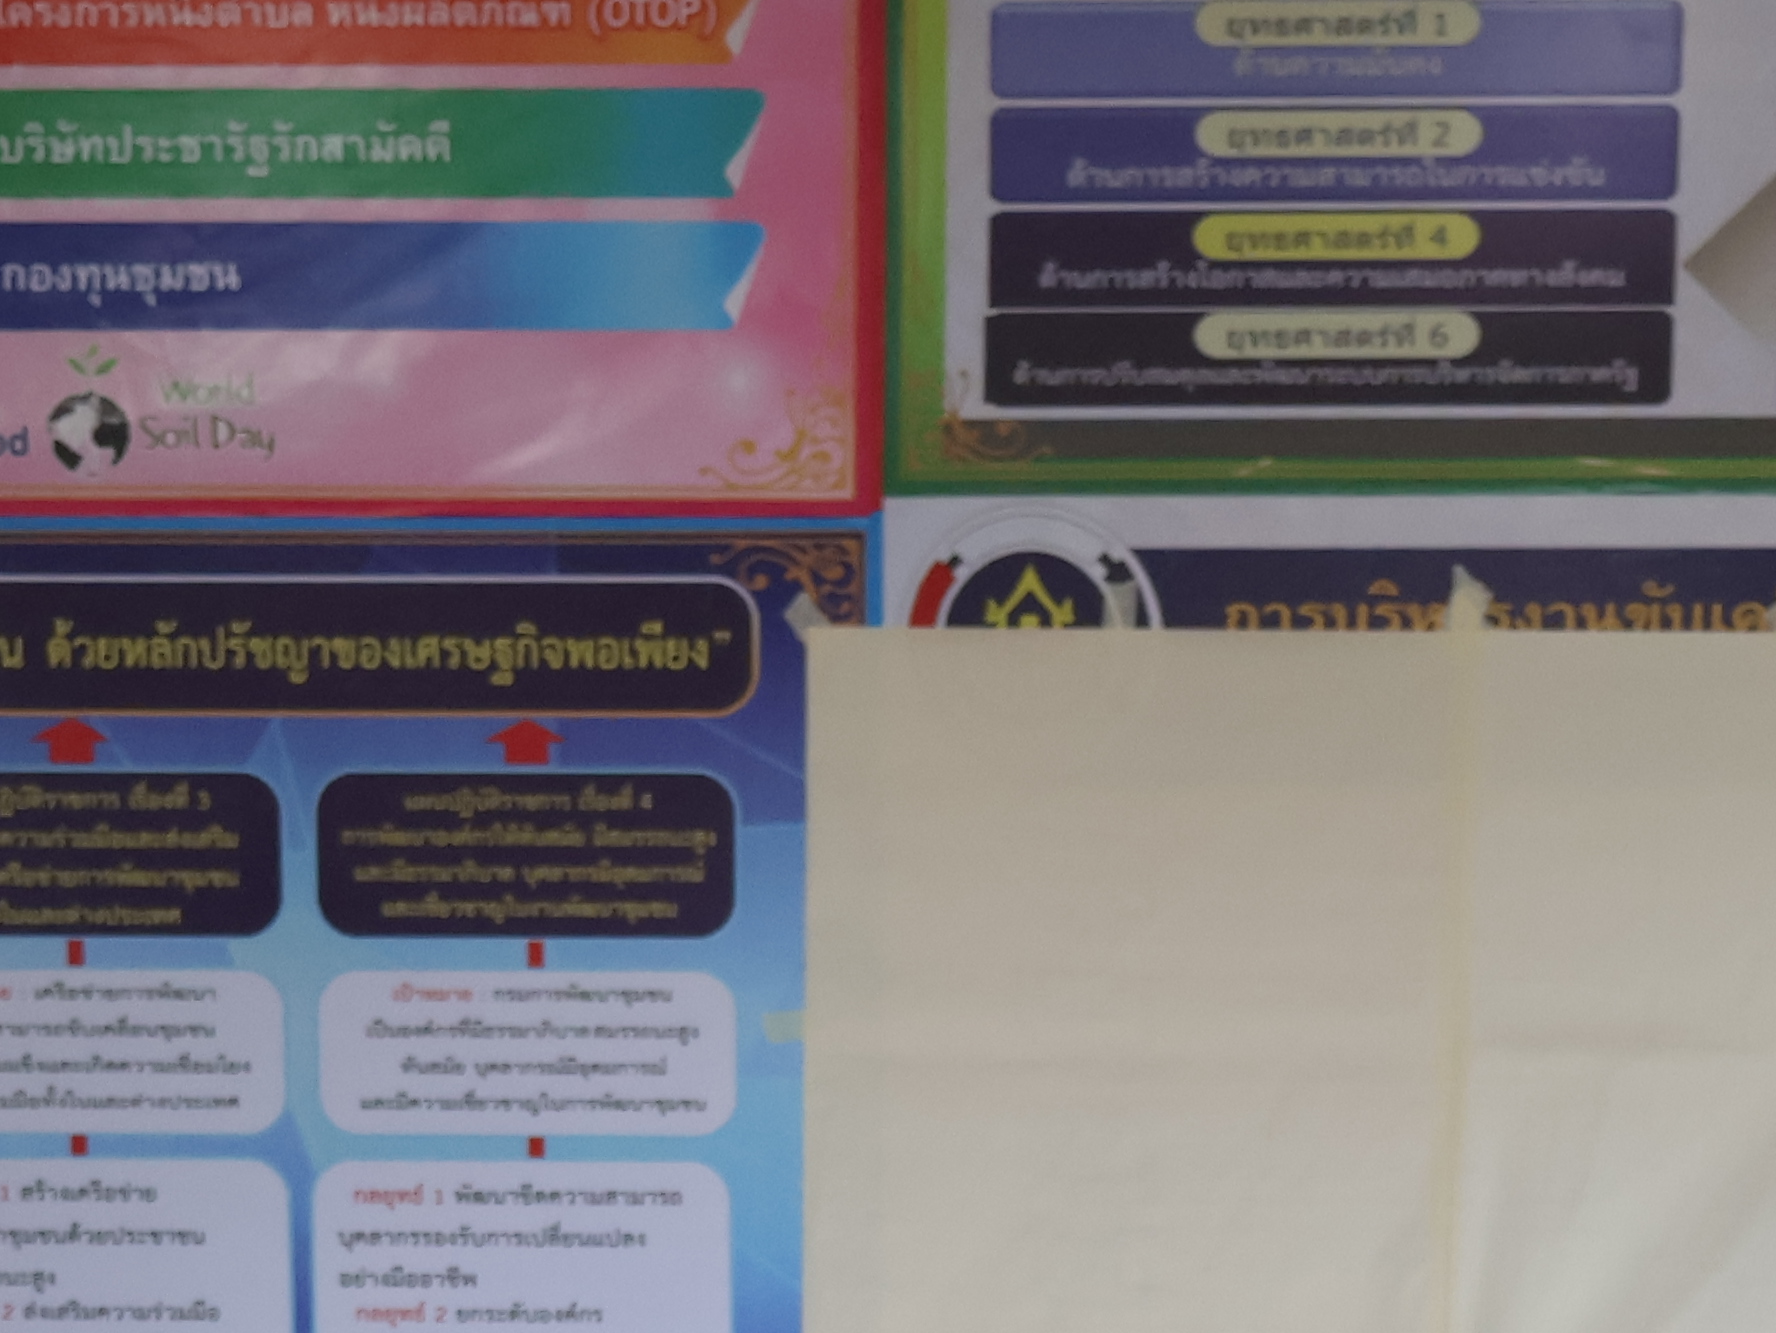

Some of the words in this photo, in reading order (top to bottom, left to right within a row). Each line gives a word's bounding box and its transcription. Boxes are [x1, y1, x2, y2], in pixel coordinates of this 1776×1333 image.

[0, 255, 242, 308] กองทุนชุมชน
[139, 415, 200, 451] Soil
[210, 418, 276, 458] Day
